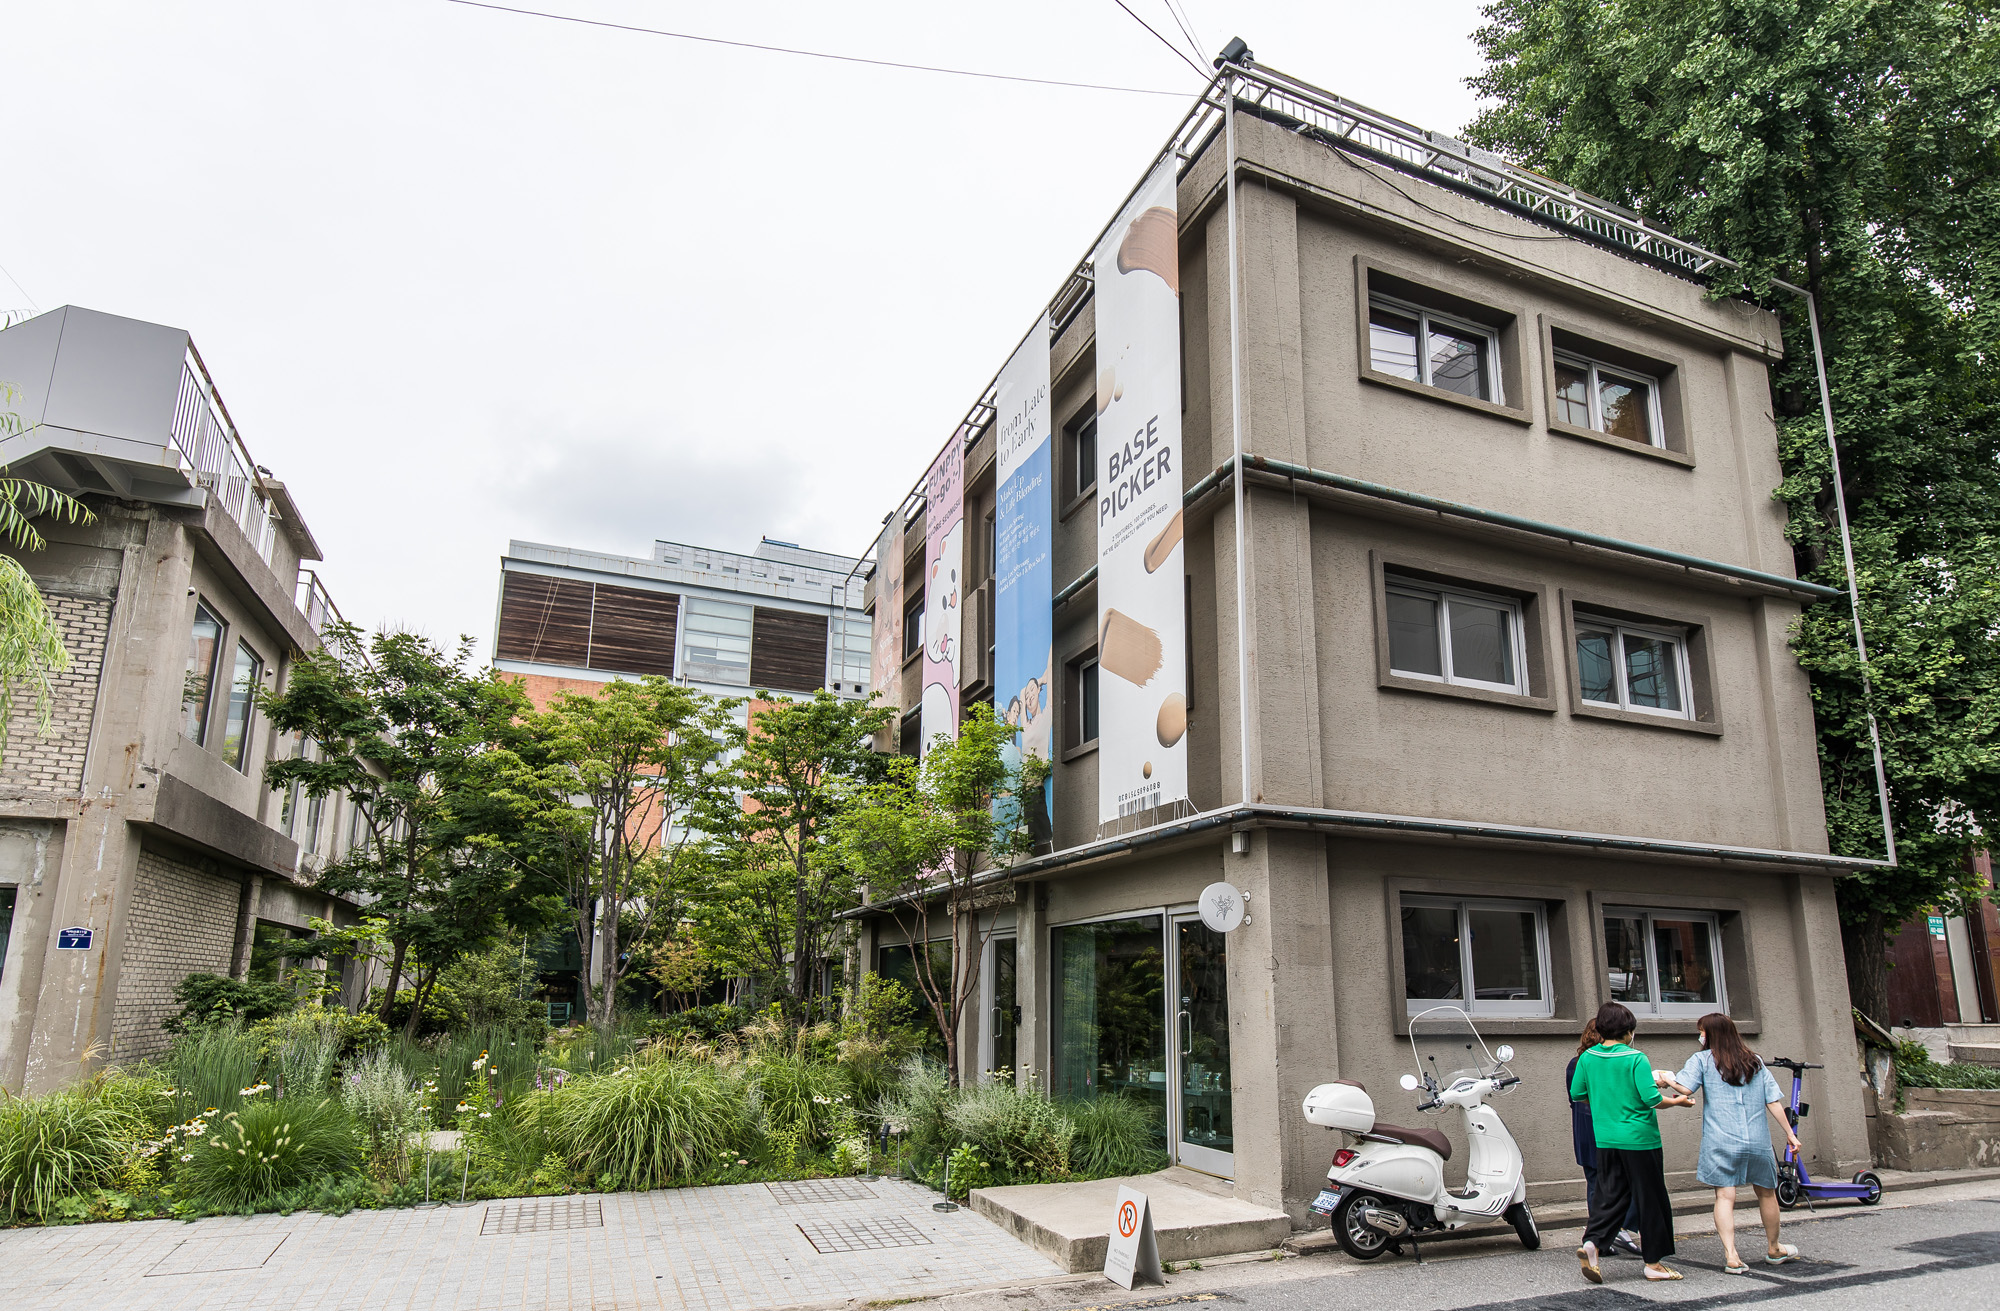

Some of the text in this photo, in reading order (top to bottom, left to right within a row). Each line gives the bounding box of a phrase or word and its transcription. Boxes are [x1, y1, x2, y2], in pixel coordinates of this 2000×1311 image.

[1000, 385, 1046, 445] from Late
[928, 438, 961, 494] FUNPPY
[1000, 418, 1036, 466] to Early
[1109, 414, 1158, 483] BASE
[929, 478, 951, 513] to-go
[1016, 472, 1042, 503] Blending
[1100, 446, 1171, 528] PICKER
[1121, 528, 1136, 544] EXACTLY
[1147, 512, 1156, 523] YOU
[71, 938, 78, 947] 7
